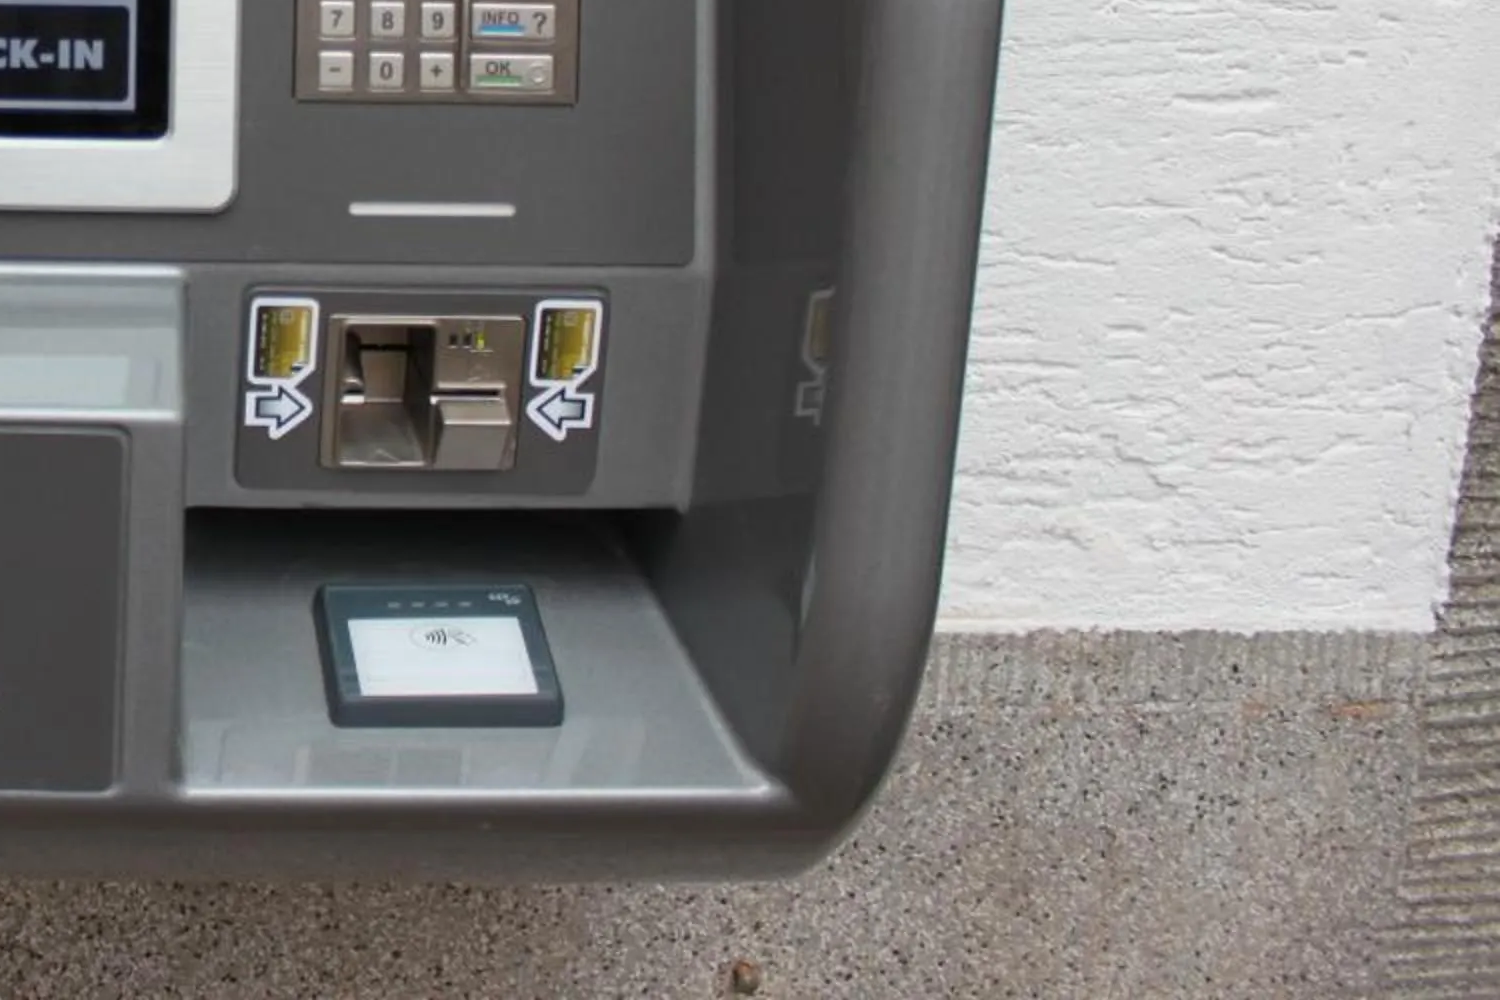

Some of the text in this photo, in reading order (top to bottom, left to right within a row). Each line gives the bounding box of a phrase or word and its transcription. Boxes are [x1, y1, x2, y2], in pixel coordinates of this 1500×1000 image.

[331, 10, 343, 27] 7
[382, 11, 394, 29] 8
[432, 13, 443, 30] 9
[482, 11, 519, 25] INFO
[380, 61, 393, 80] 0
[486, 61, 511, 75] OK
